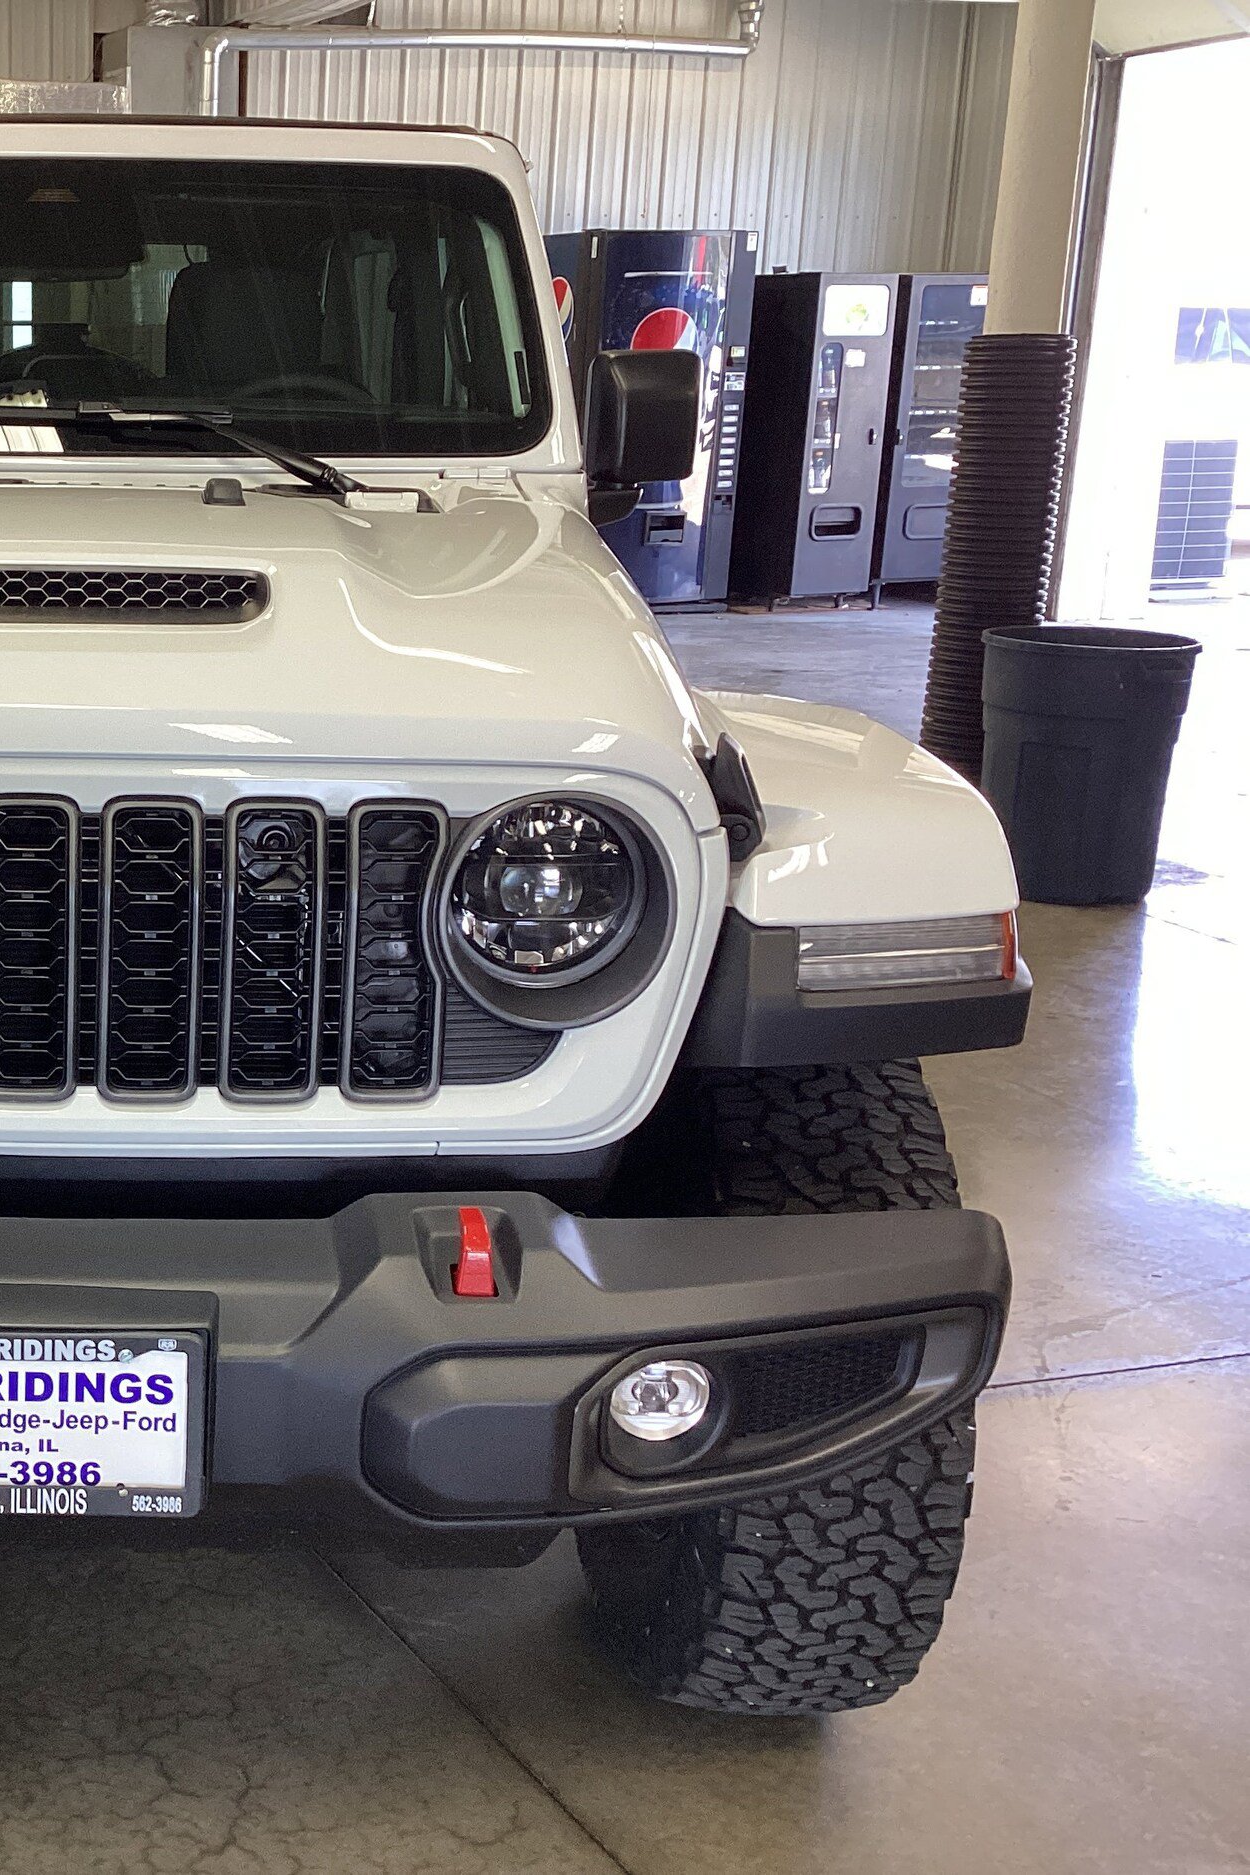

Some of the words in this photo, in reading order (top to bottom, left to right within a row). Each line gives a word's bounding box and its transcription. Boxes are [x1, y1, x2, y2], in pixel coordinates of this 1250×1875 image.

[38, 1438, 59, 1452] IL
[10, 1488, 88, 1515] ILLINOIS
[131, 1495, 182, 1513] 562-3986
